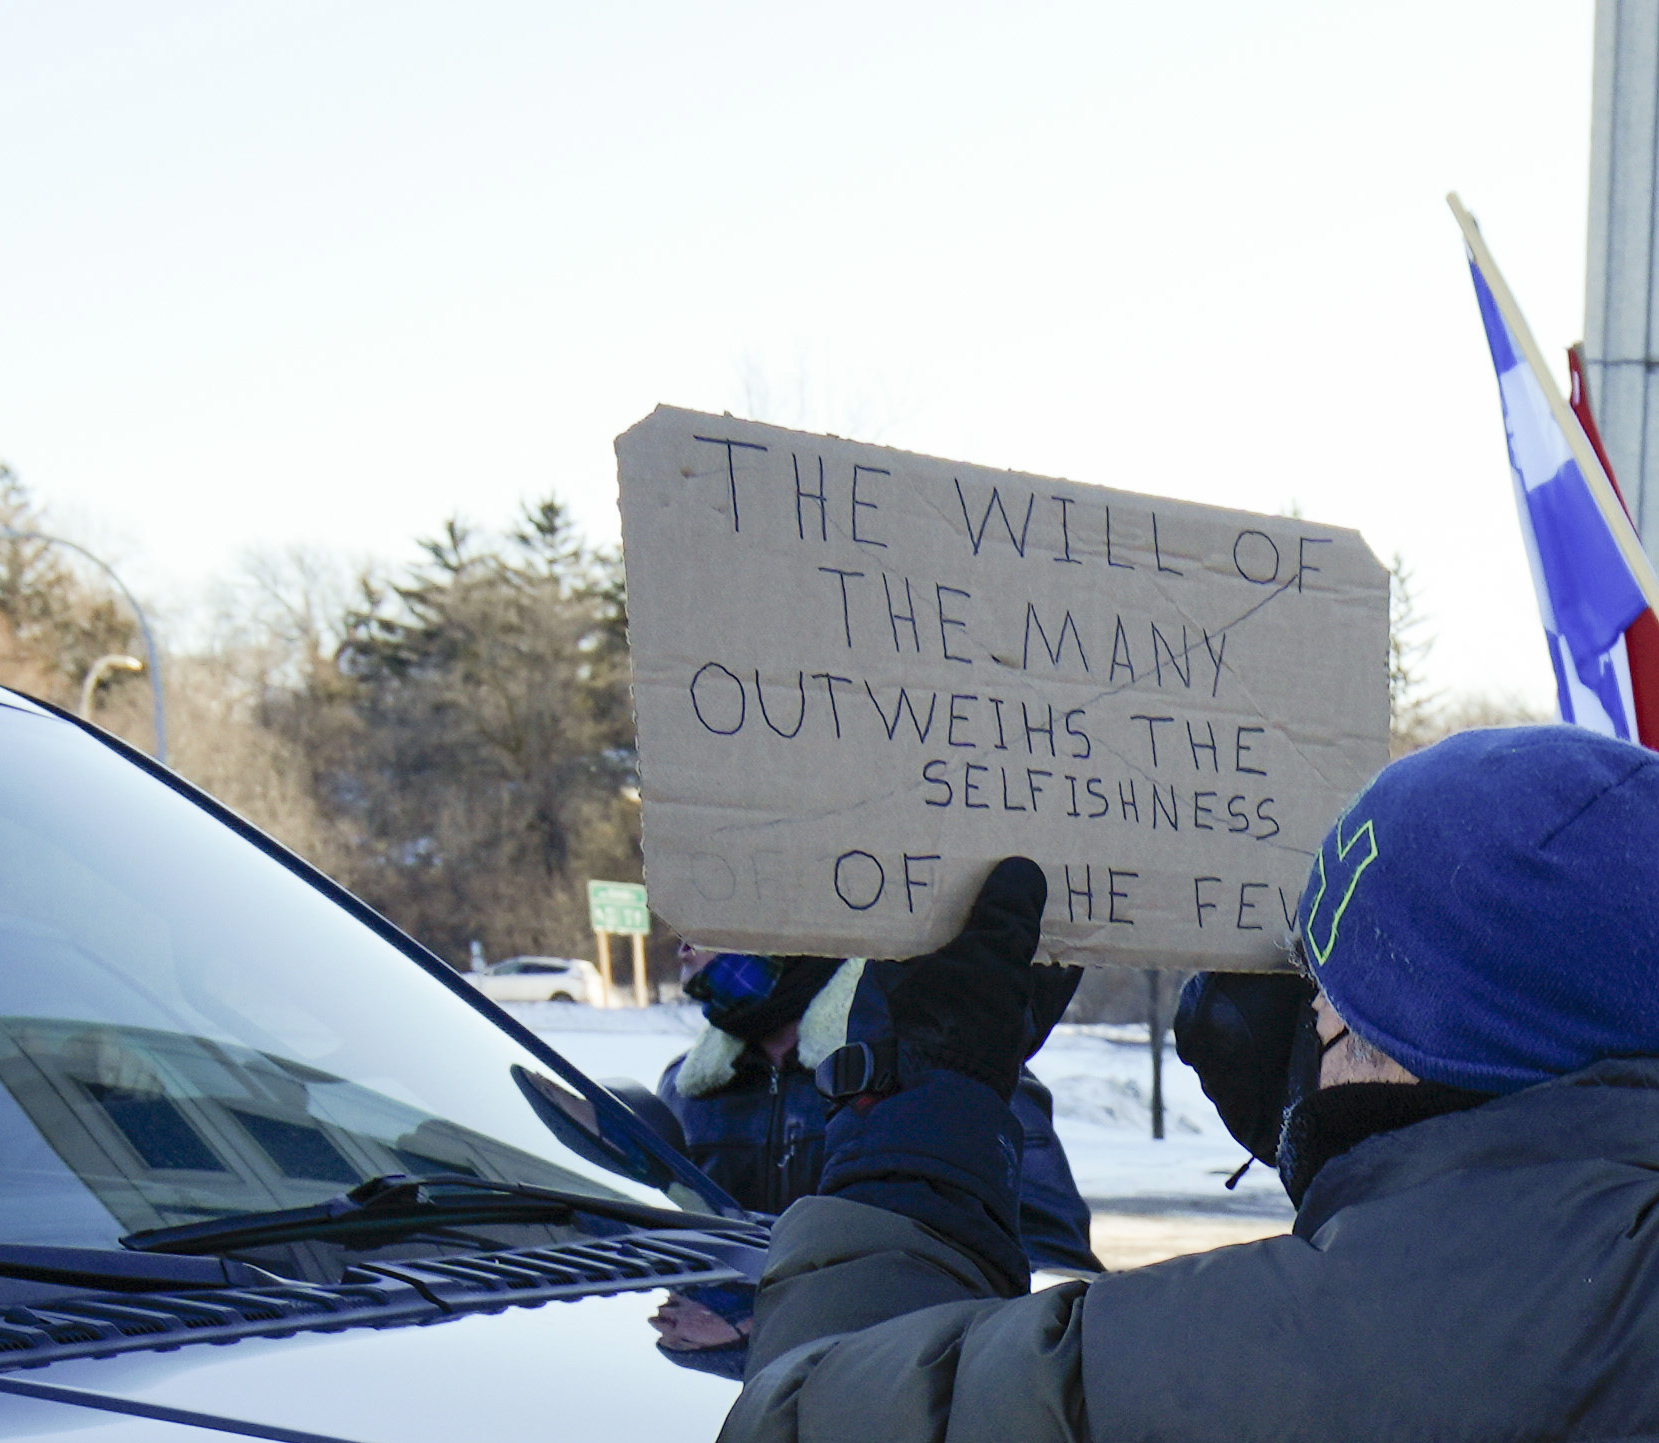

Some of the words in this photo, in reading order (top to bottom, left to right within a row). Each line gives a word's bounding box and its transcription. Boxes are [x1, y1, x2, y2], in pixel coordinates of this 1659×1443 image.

[693, 434, 890, 548] THE
[954, 477, 1183, 576] WILL
[1232, 529, 1333, 593] OF
[818, 567, 972, 664] THE
[1024, 603, 1227, 697] MANY
[690, 661, 1092, 760] OUTWEIHS
[1131, 715, 1268, 777] THE
[922, 759, 1280, 841] SELFISHNESS
[834, 850, 941, 914] OF
[1064, 864, 1141, 925] HE
